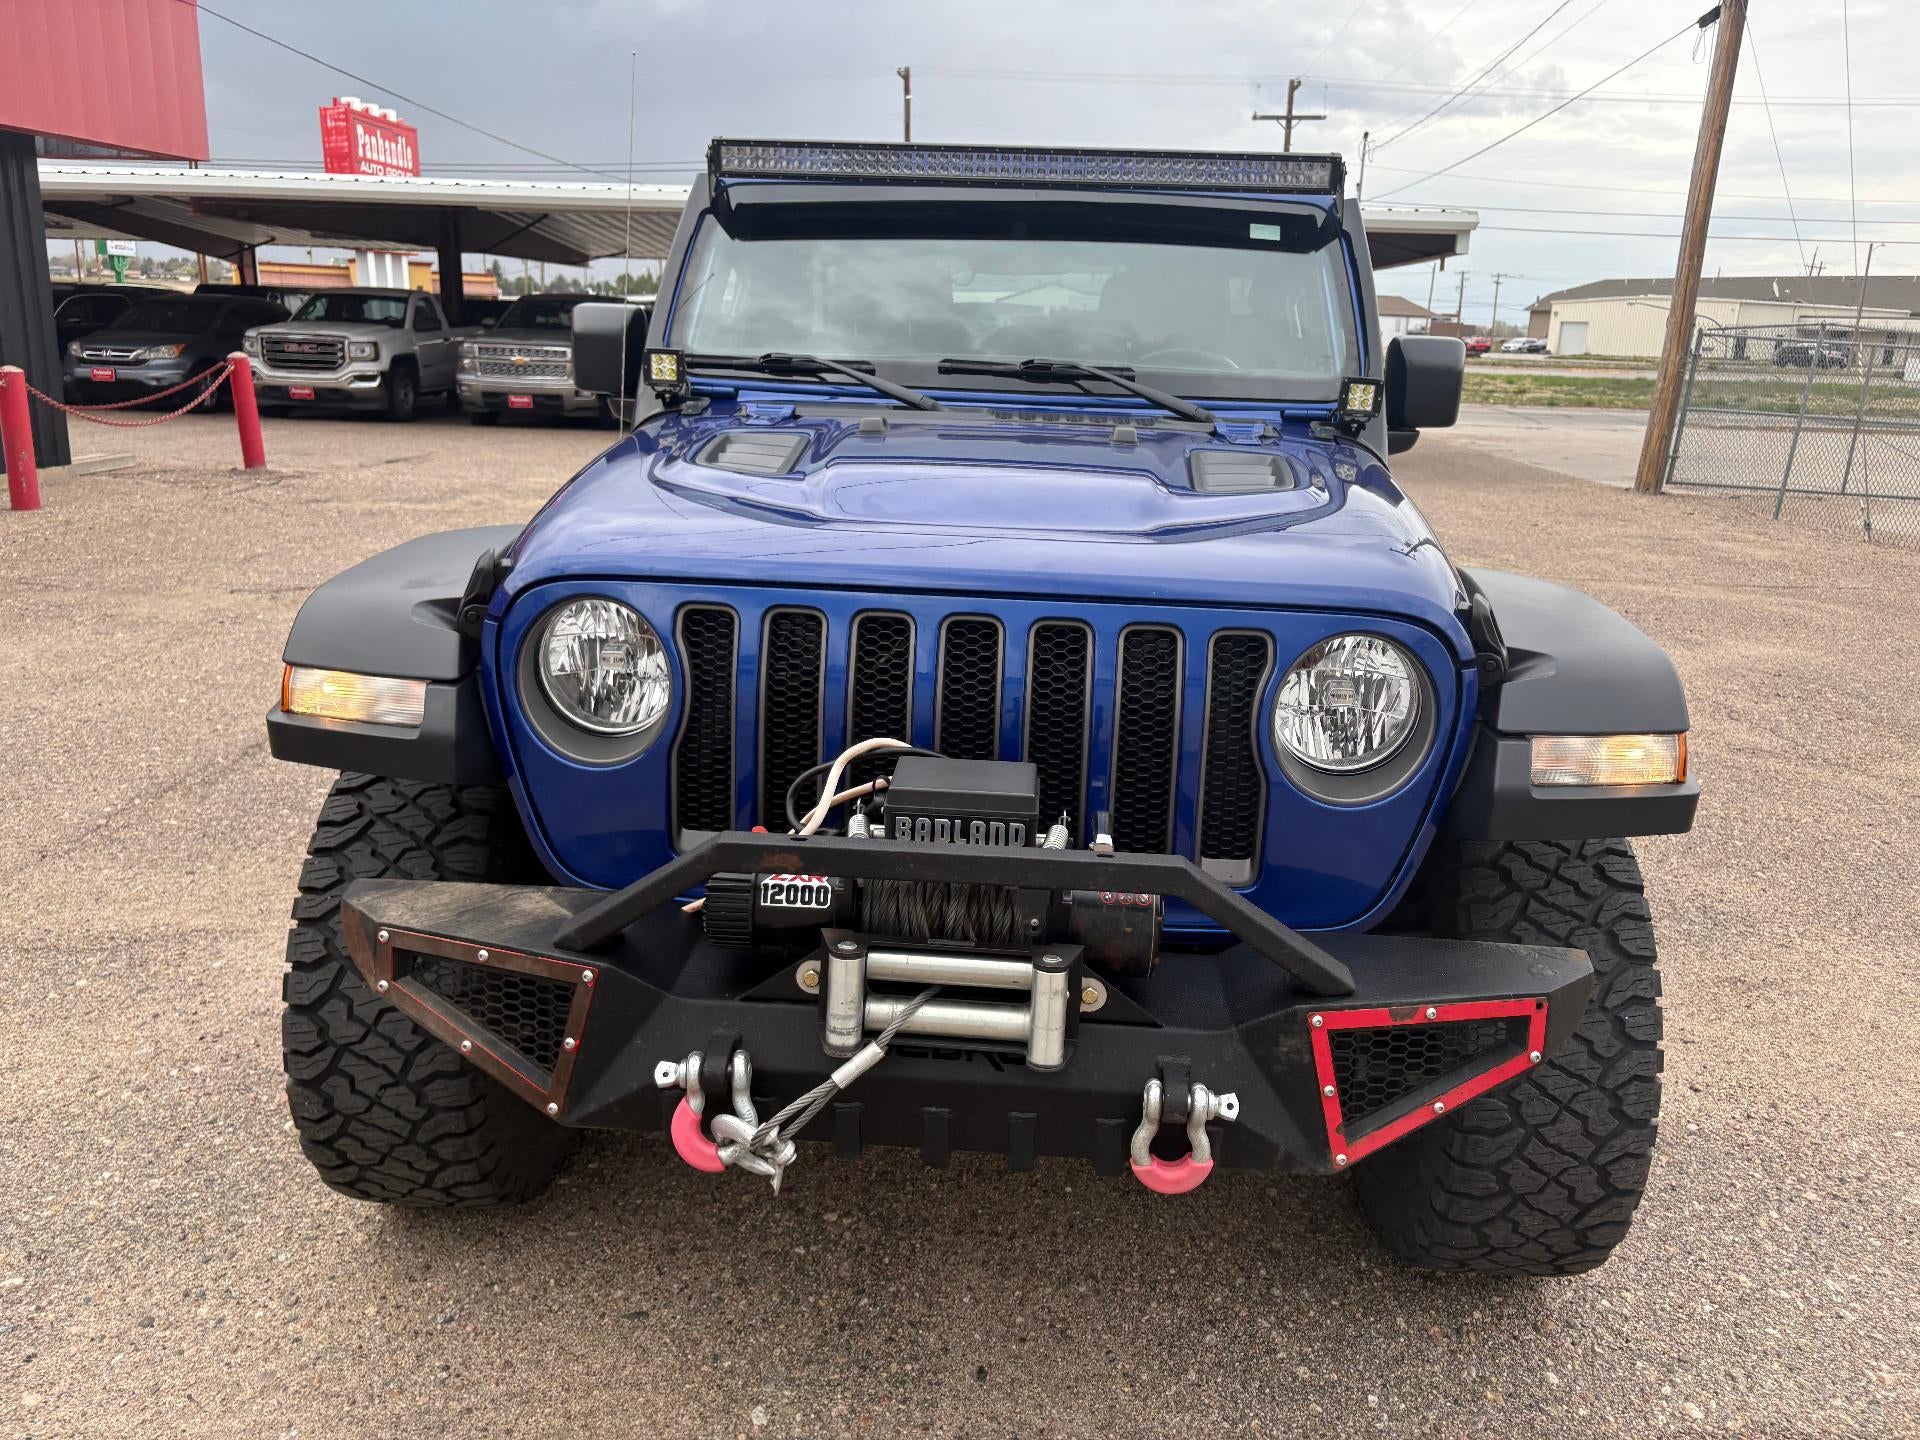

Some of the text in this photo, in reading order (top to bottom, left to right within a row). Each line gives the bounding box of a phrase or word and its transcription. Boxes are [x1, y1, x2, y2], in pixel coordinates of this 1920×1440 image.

[357, 123, 413, 170] Panhandle
[360, 161, 384, 176] AUTO
[895, 816, 1026, 847] BADLAND
[762, 882, 831, 907] 12000
